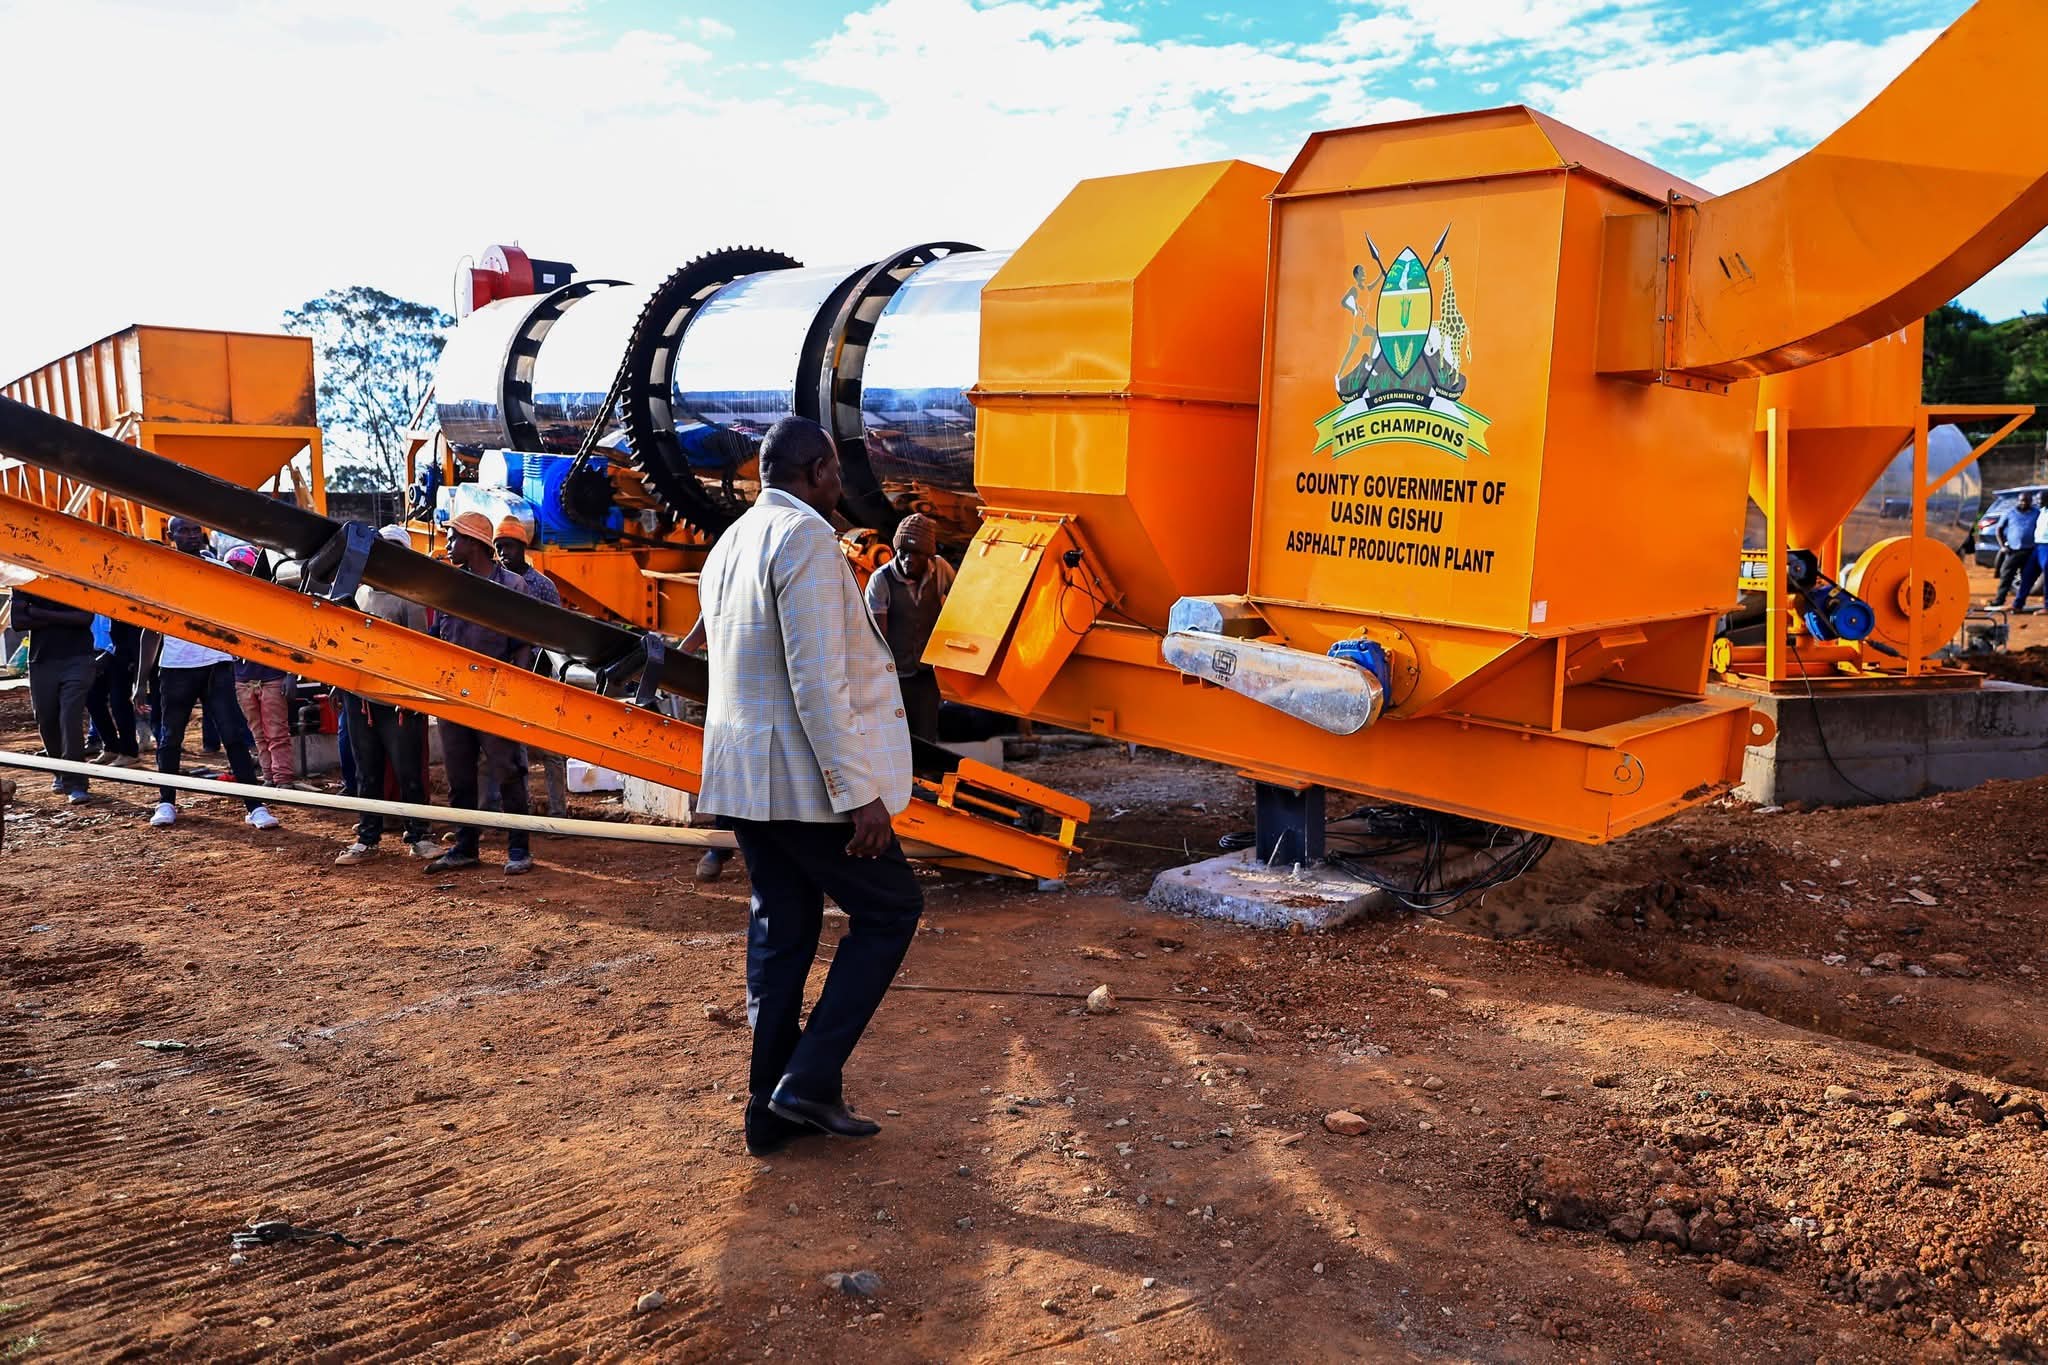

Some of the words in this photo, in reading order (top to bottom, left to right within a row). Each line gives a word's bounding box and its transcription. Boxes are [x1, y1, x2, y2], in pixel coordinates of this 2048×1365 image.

[1373, 392, 1415, 404] GOVERNMENT
[1335, 424, 1366, 447] THE
[1370, 418, 1464, 447] CHAMPIONS
[1296, 471, 1360, 496] COUNTY
[1363, 475, 1478, 503] GOVERNMENT
[1482, 481, 1506, 505] OF
[1331, 501, 1383, 527] UASIN
[1387, 506, 1443, 533] GISHU
[1286, 530, 1346, 557] ASPHALT
[1348, 536, 1441, 568] PRODUCTION
[1444, 546, 1495, 574] PLANT
